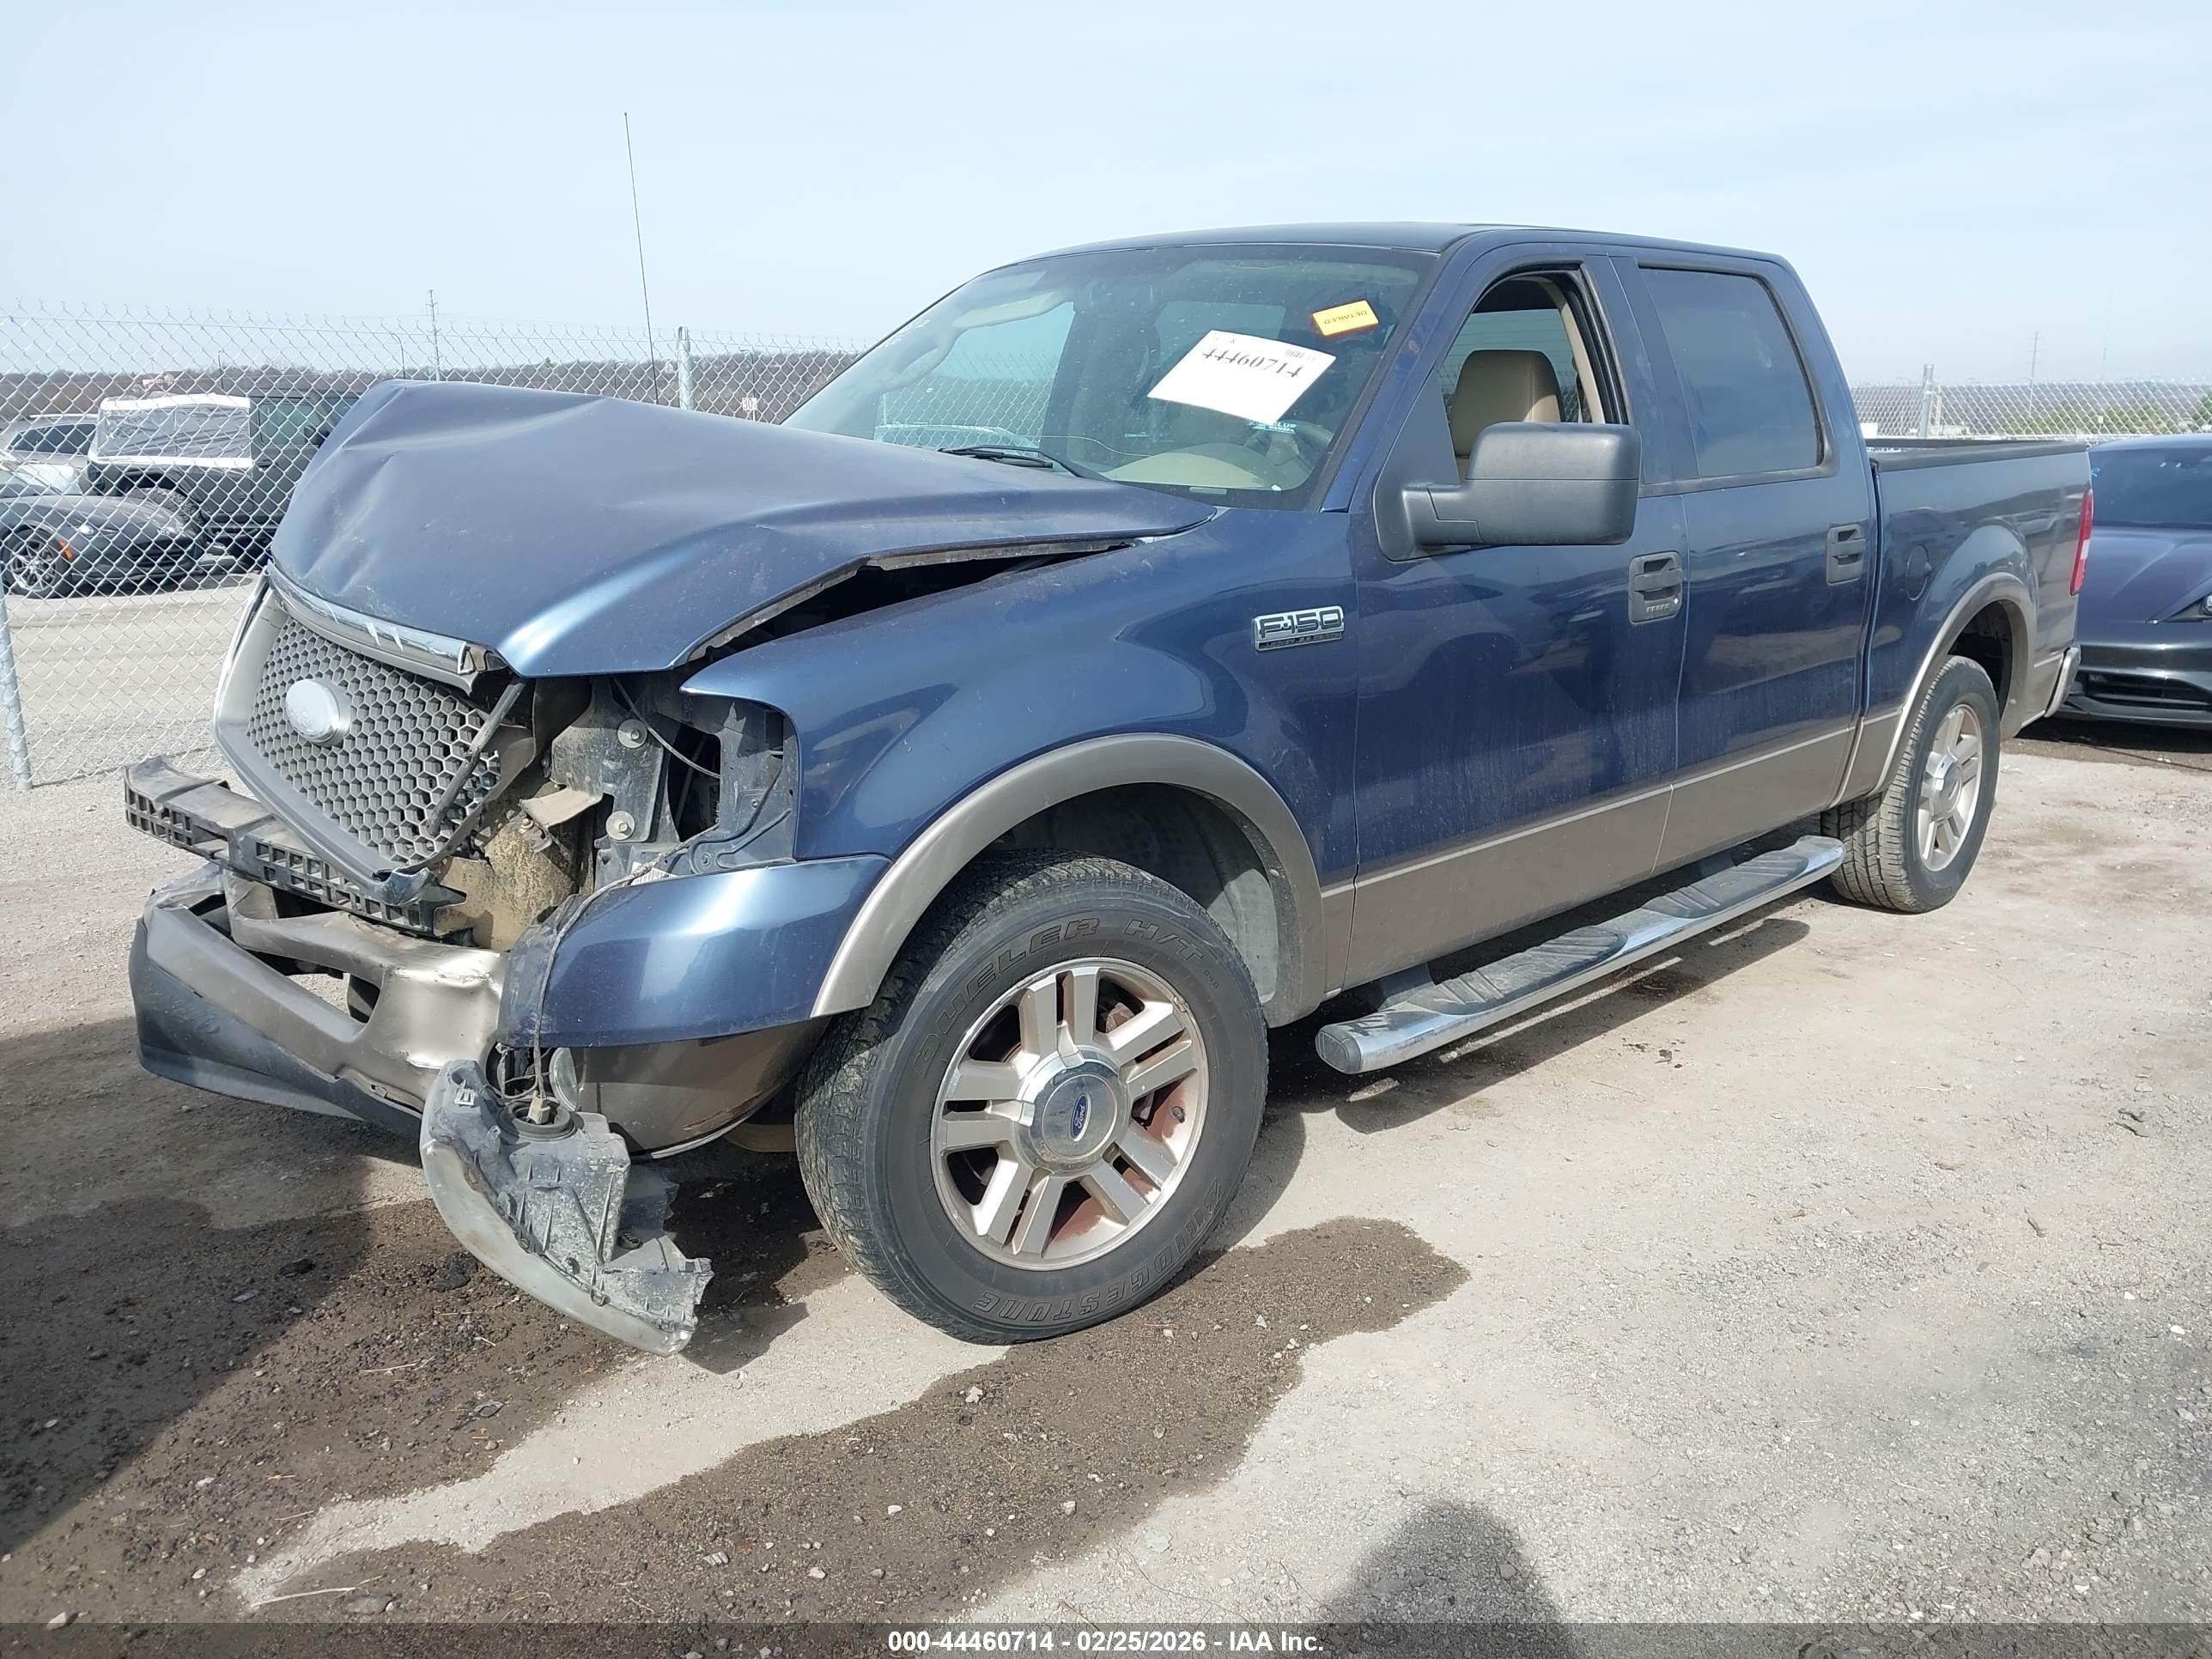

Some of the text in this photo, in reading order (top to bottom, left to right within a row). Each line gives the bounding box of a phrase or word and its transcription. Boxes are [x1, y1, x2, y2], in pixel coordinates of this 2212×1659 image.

[1202, 348, 1304, 378] 44460714
[913, 918, 1100, 1079] DUELER
[1123, 919, 1205, 962] H/T
[1073, 1104, 1085, 1129] Ford
